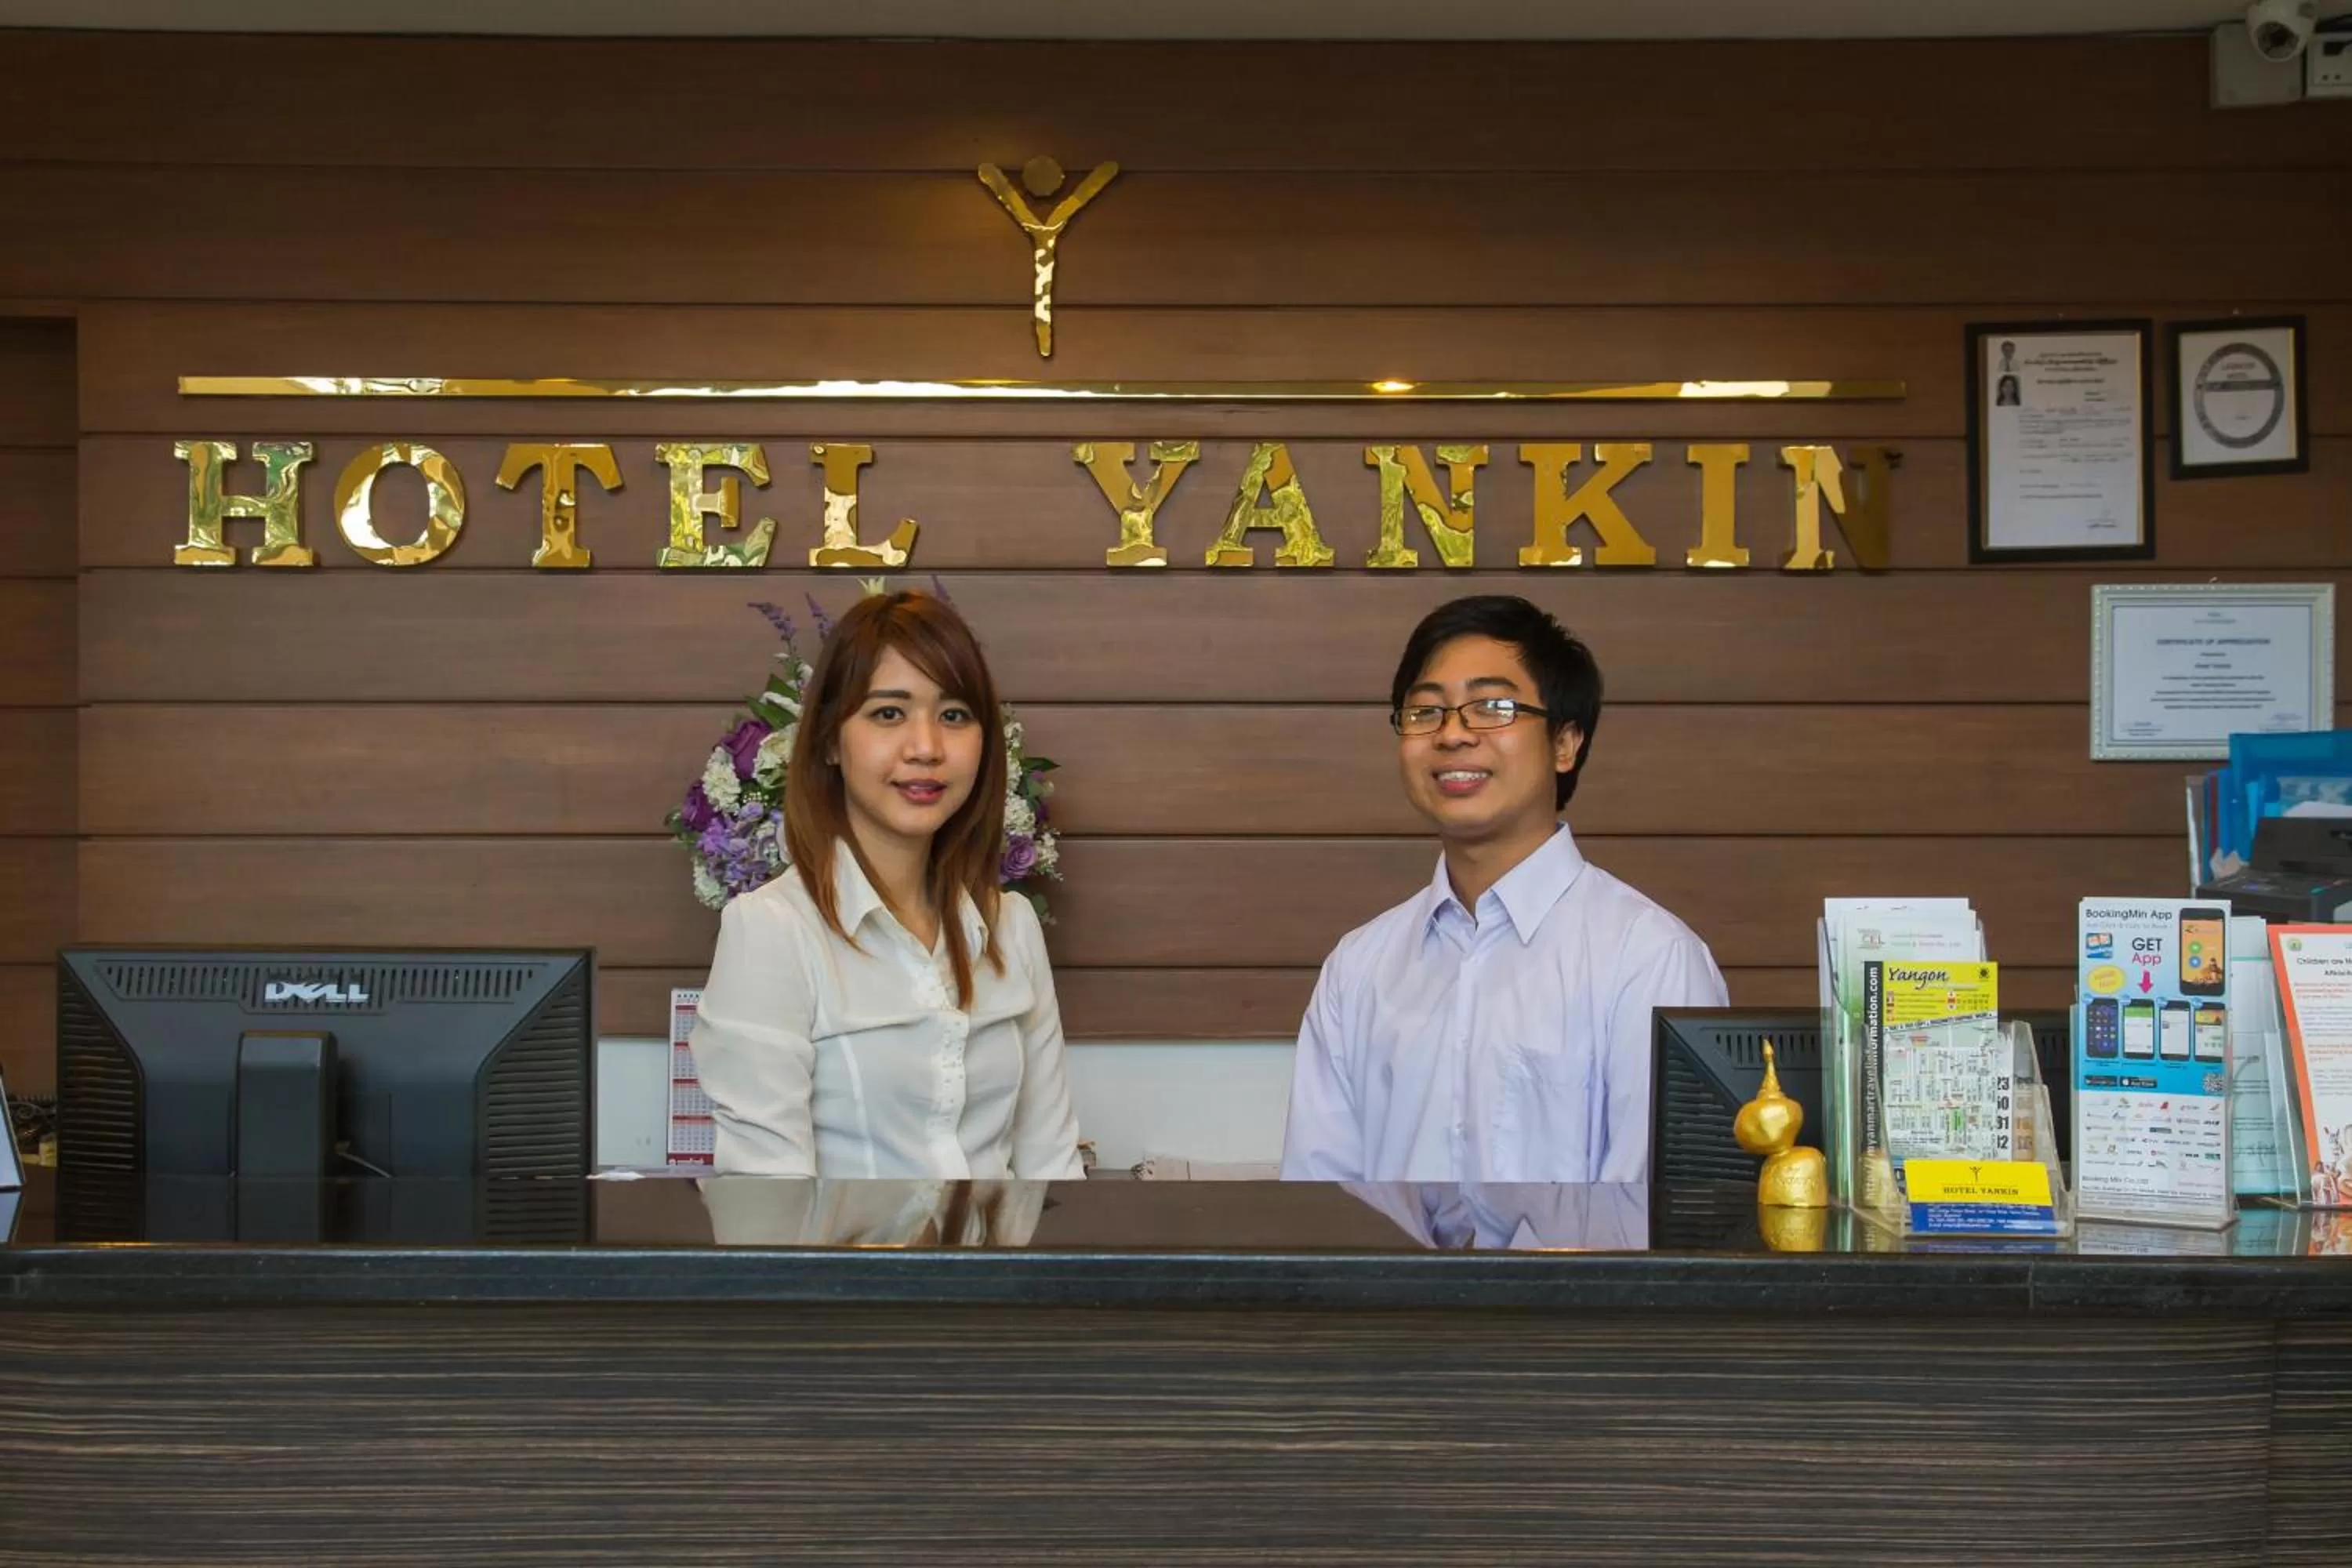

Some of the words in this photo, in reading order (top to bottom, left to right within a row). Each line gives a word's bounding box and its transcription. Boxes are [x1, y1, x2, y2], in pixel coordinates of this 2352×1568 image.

[174, 441, 919, 568] HOTEL
[1073, 441, 1900, 570] YANKIN
[2085, 909, 2147, 920] BookingMin
[2151, 910, 2172, 920] App
[2132, 937, 2162, 951] GET
[2132, 953, 2161, 966] App
[1888, 967, 1950, 990] Yangon
[264, 982, 369, 1004] DELL
[1980, 1187, 2019, 1196] YANKIN
